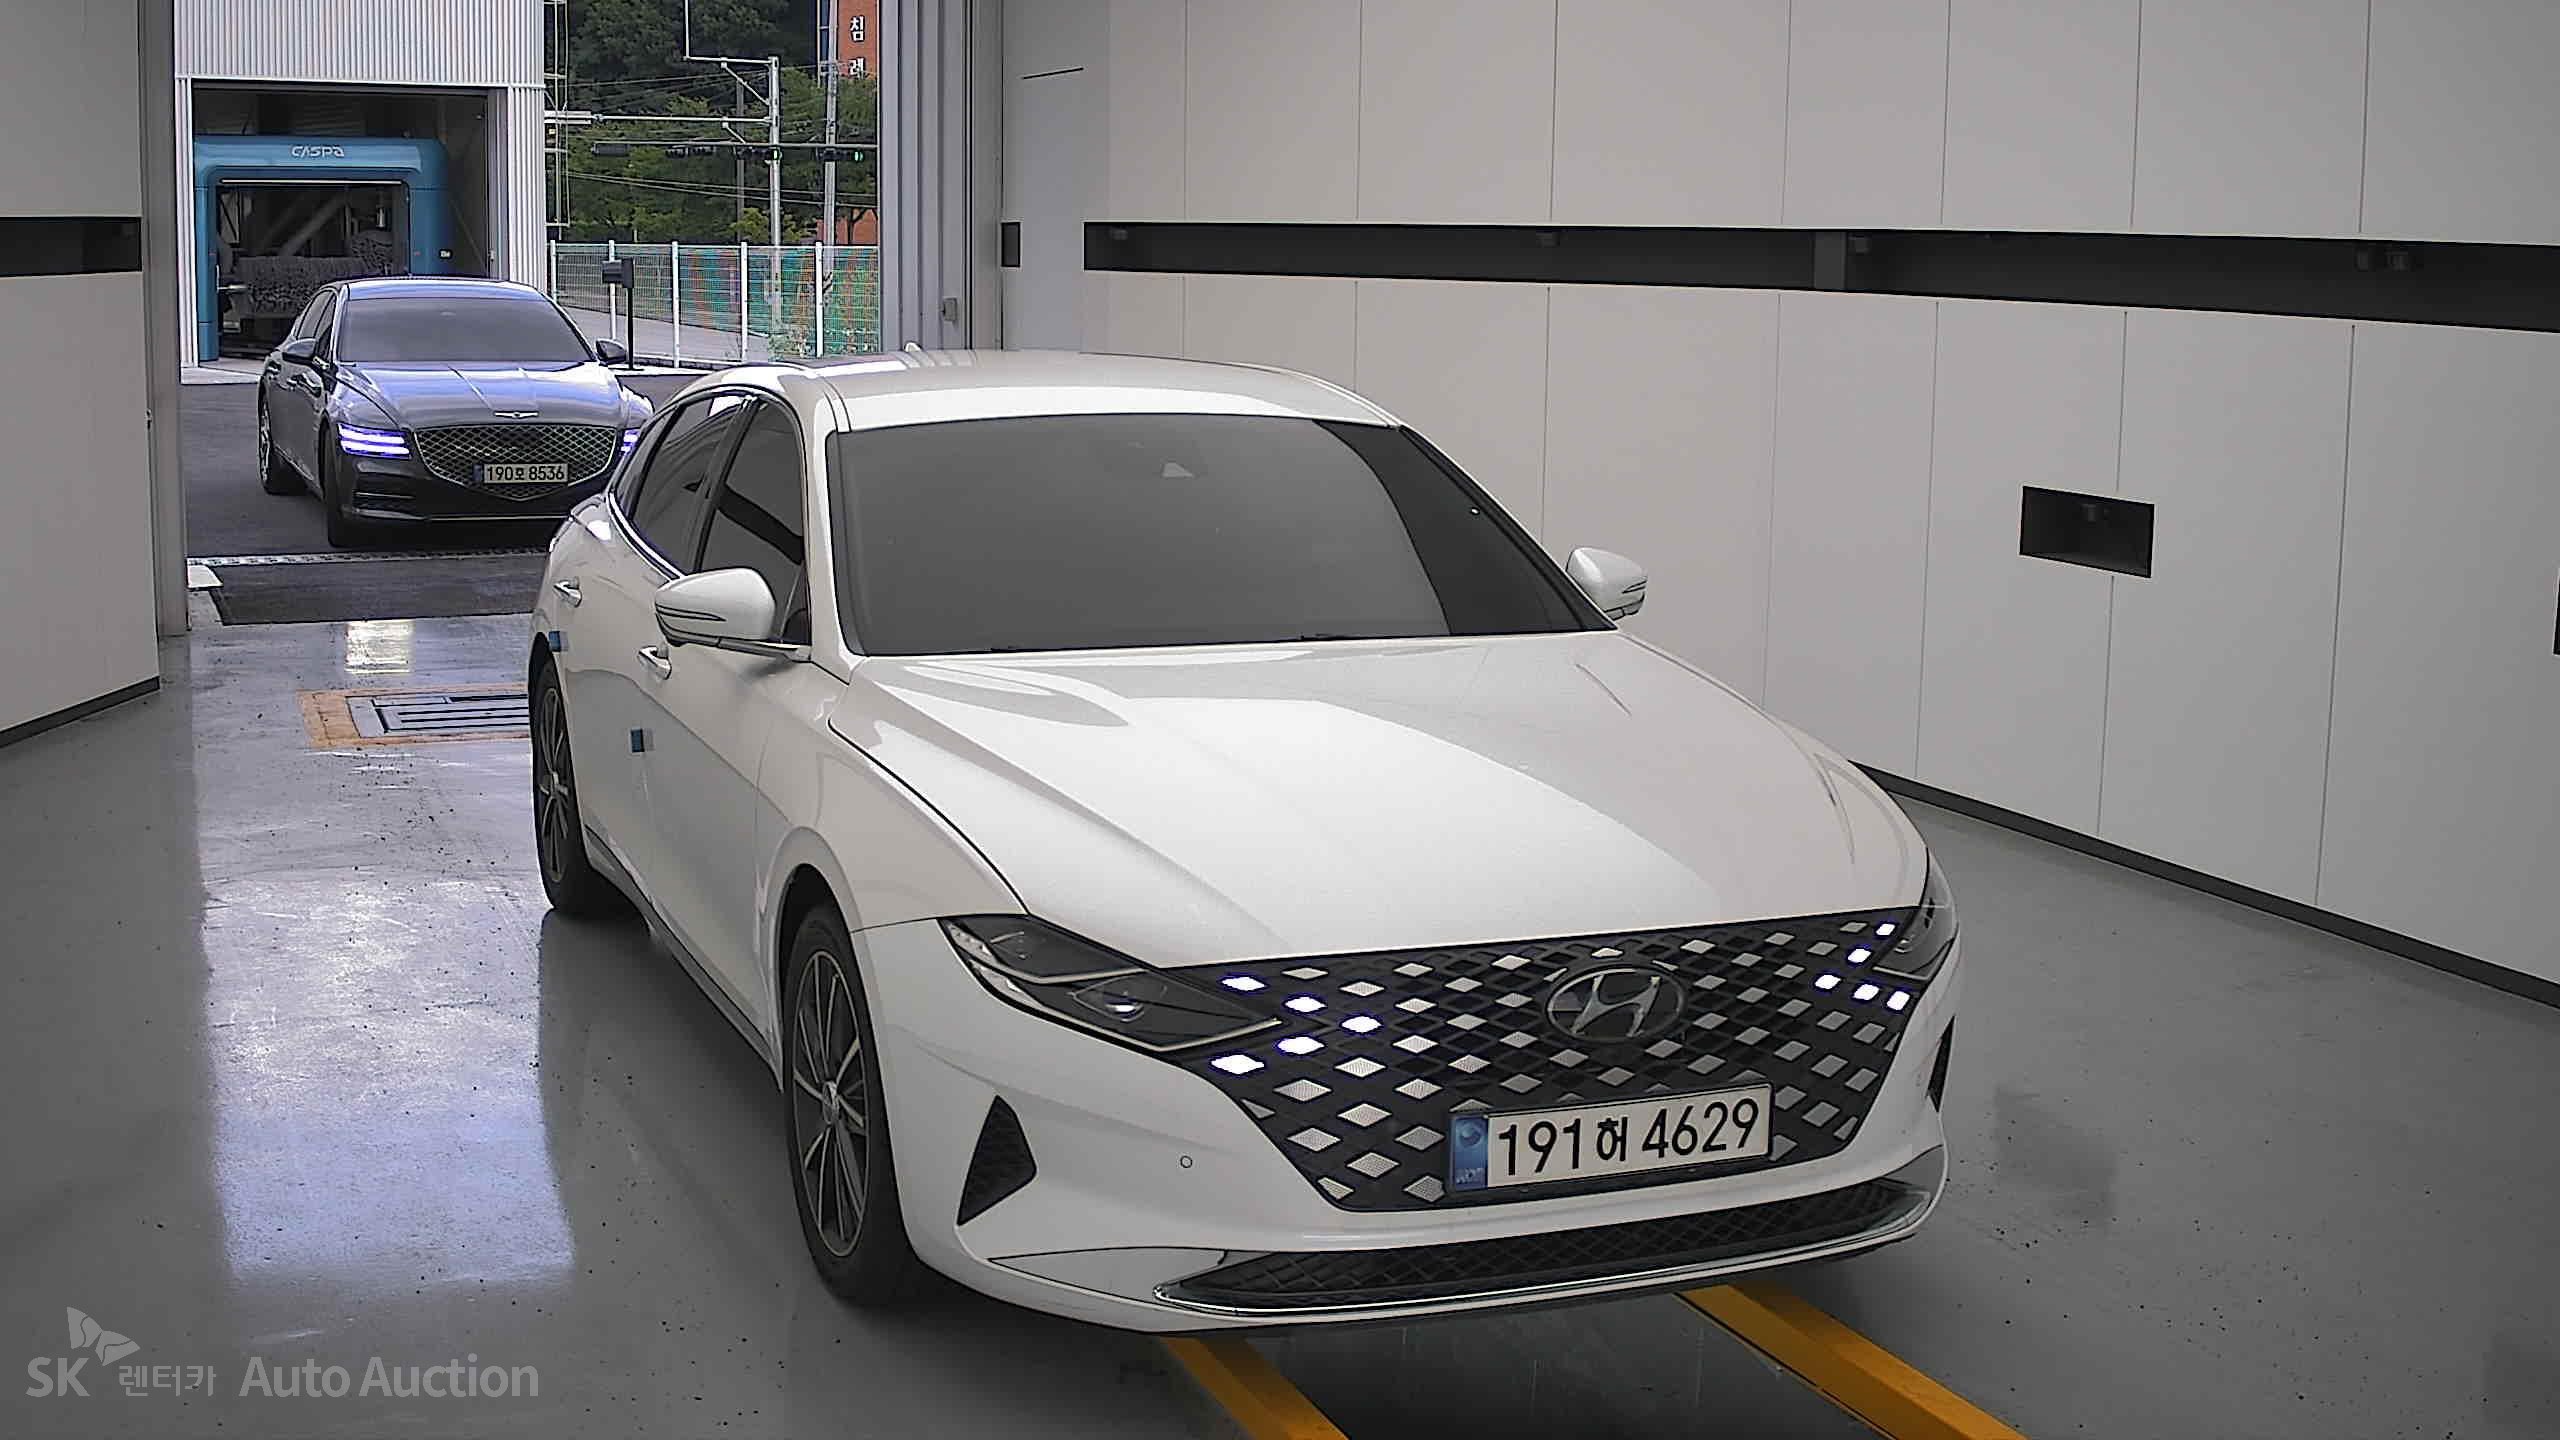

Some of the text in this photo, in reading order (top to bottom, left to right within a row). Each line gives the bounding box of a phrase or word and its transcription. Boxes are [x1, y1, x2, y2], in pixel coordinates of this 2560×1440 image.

[528, 465, 565, 481] 8536
[1498, 1097, 1760, 1177] 191허 4629
